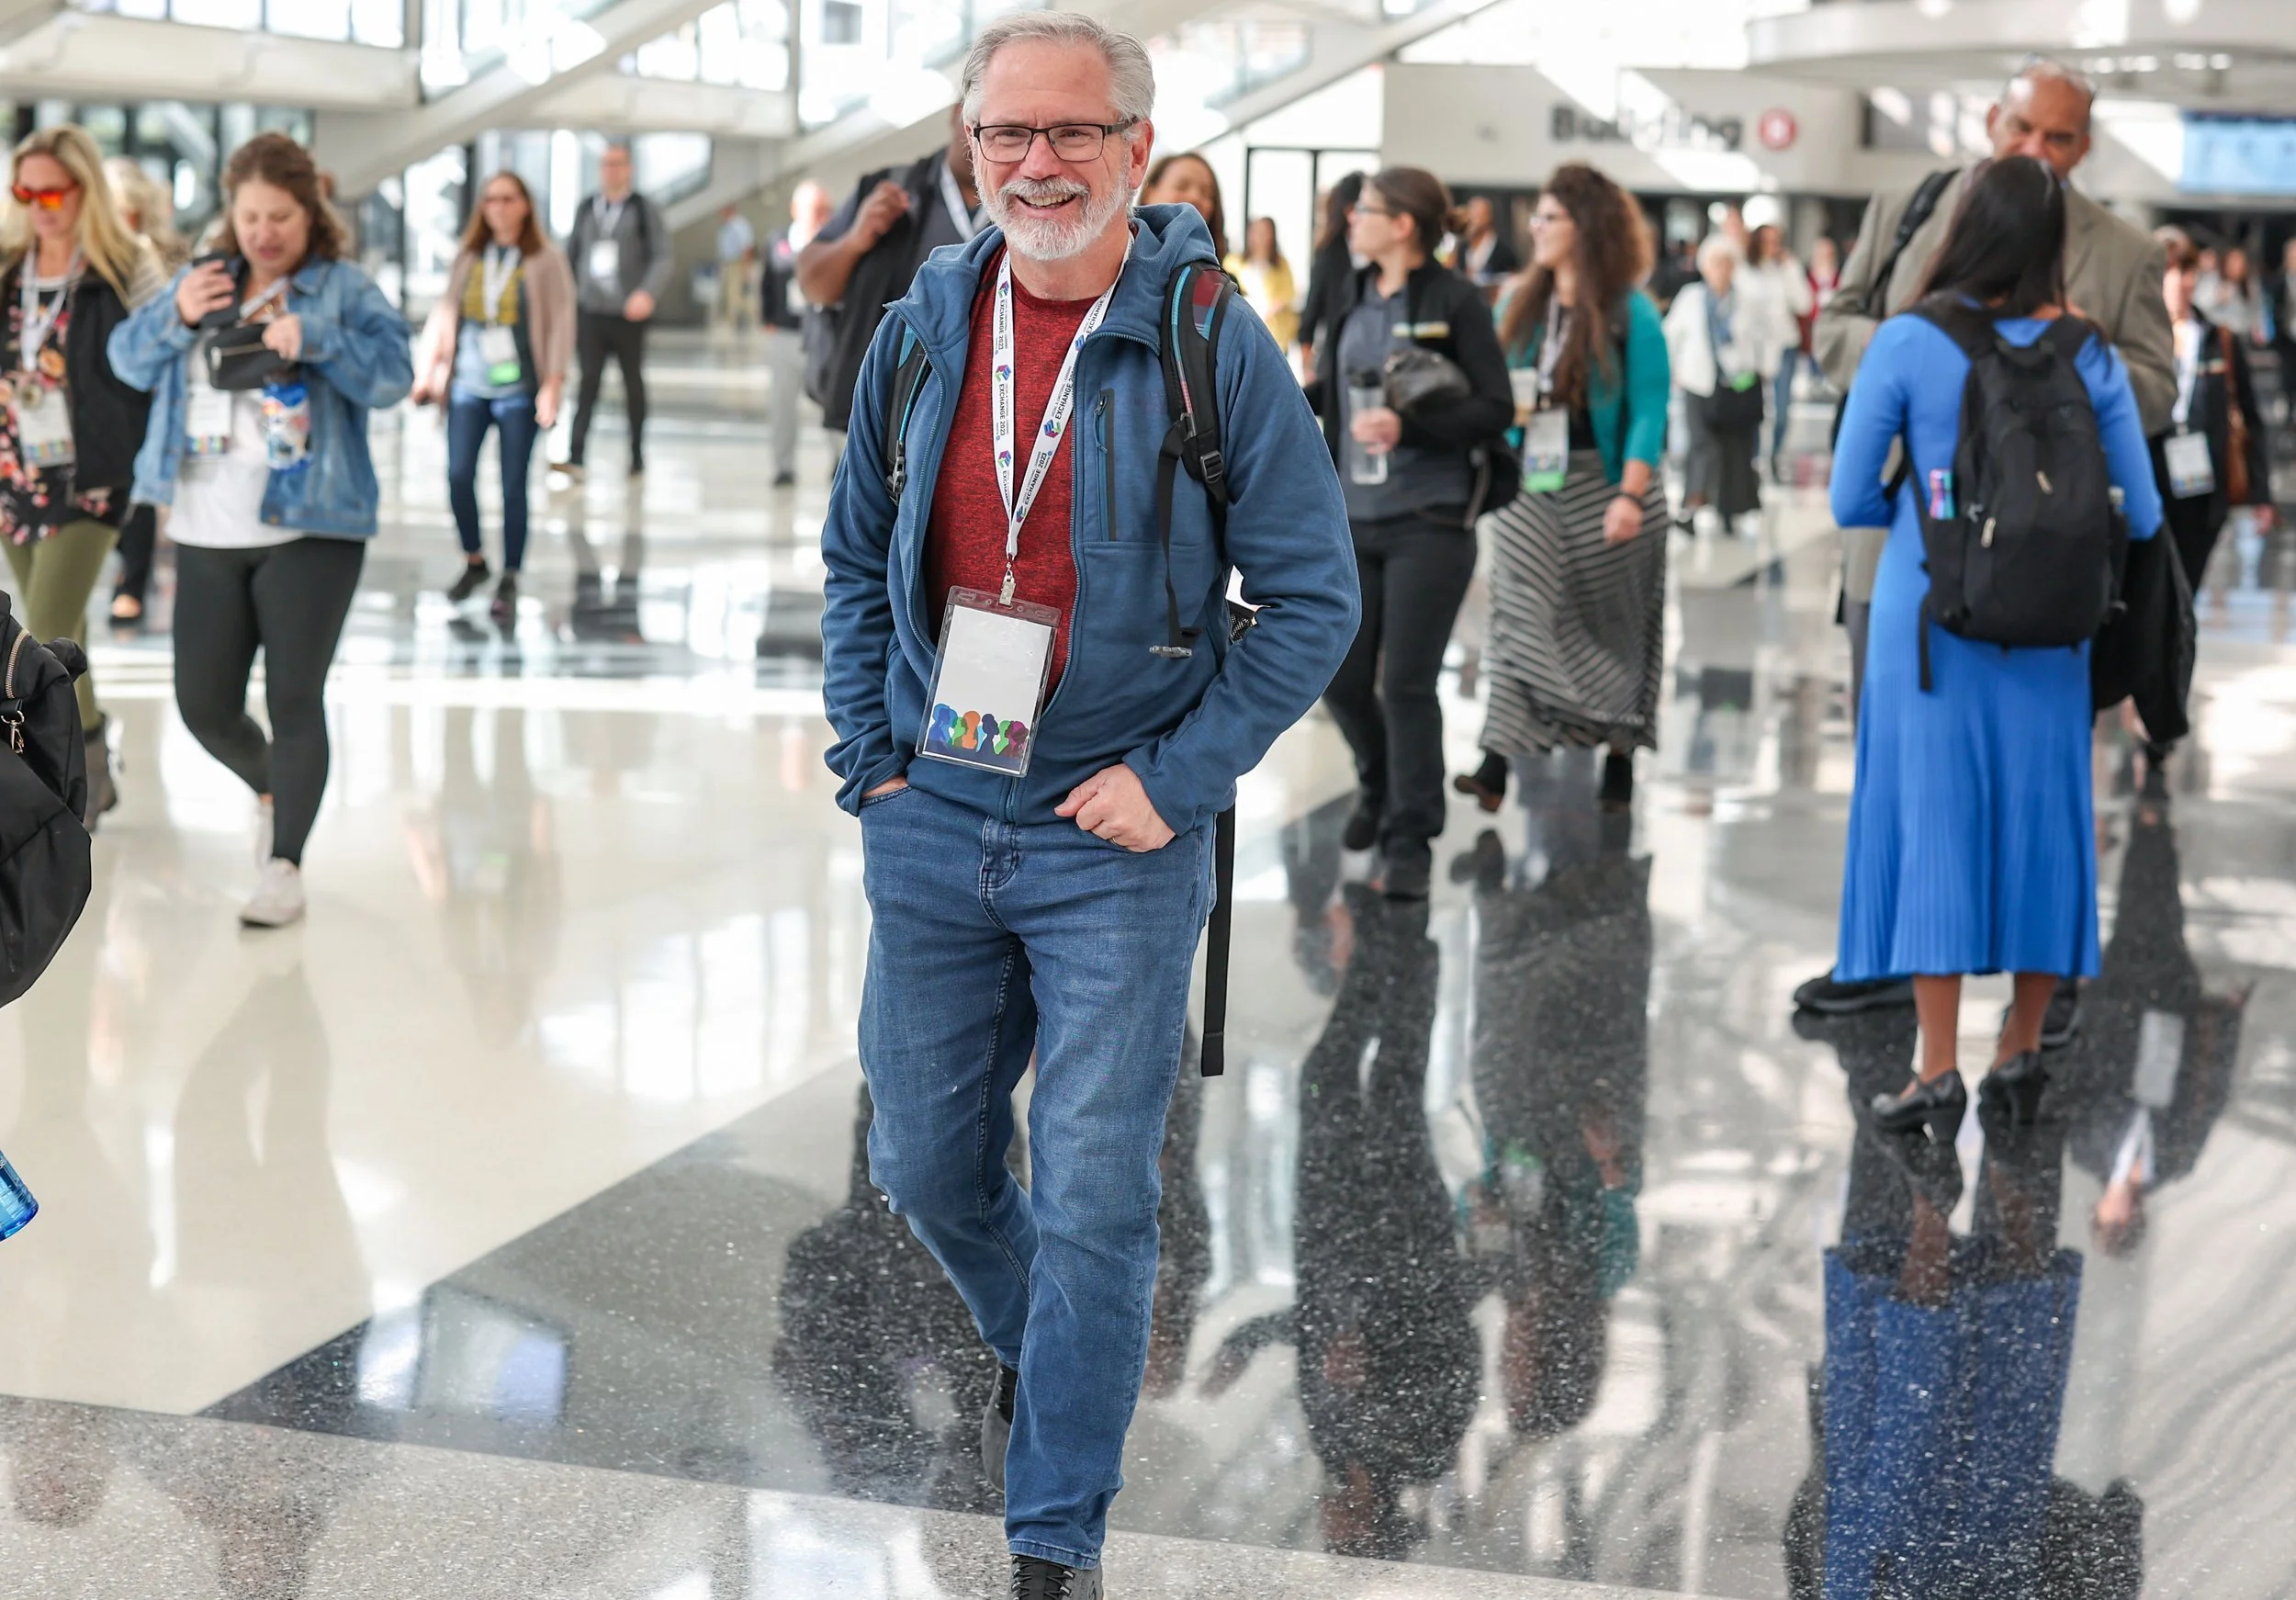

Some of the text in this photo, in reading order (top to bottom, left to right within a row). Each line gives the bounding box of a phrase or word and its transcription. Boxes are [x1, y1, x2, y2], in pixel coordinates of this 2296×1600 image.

[1055, 383, 1073, 420] EXCHANGE
[1024, 469, 1041, 505] EXCHANGE
[1038, 452, 1047, 468] 2023
